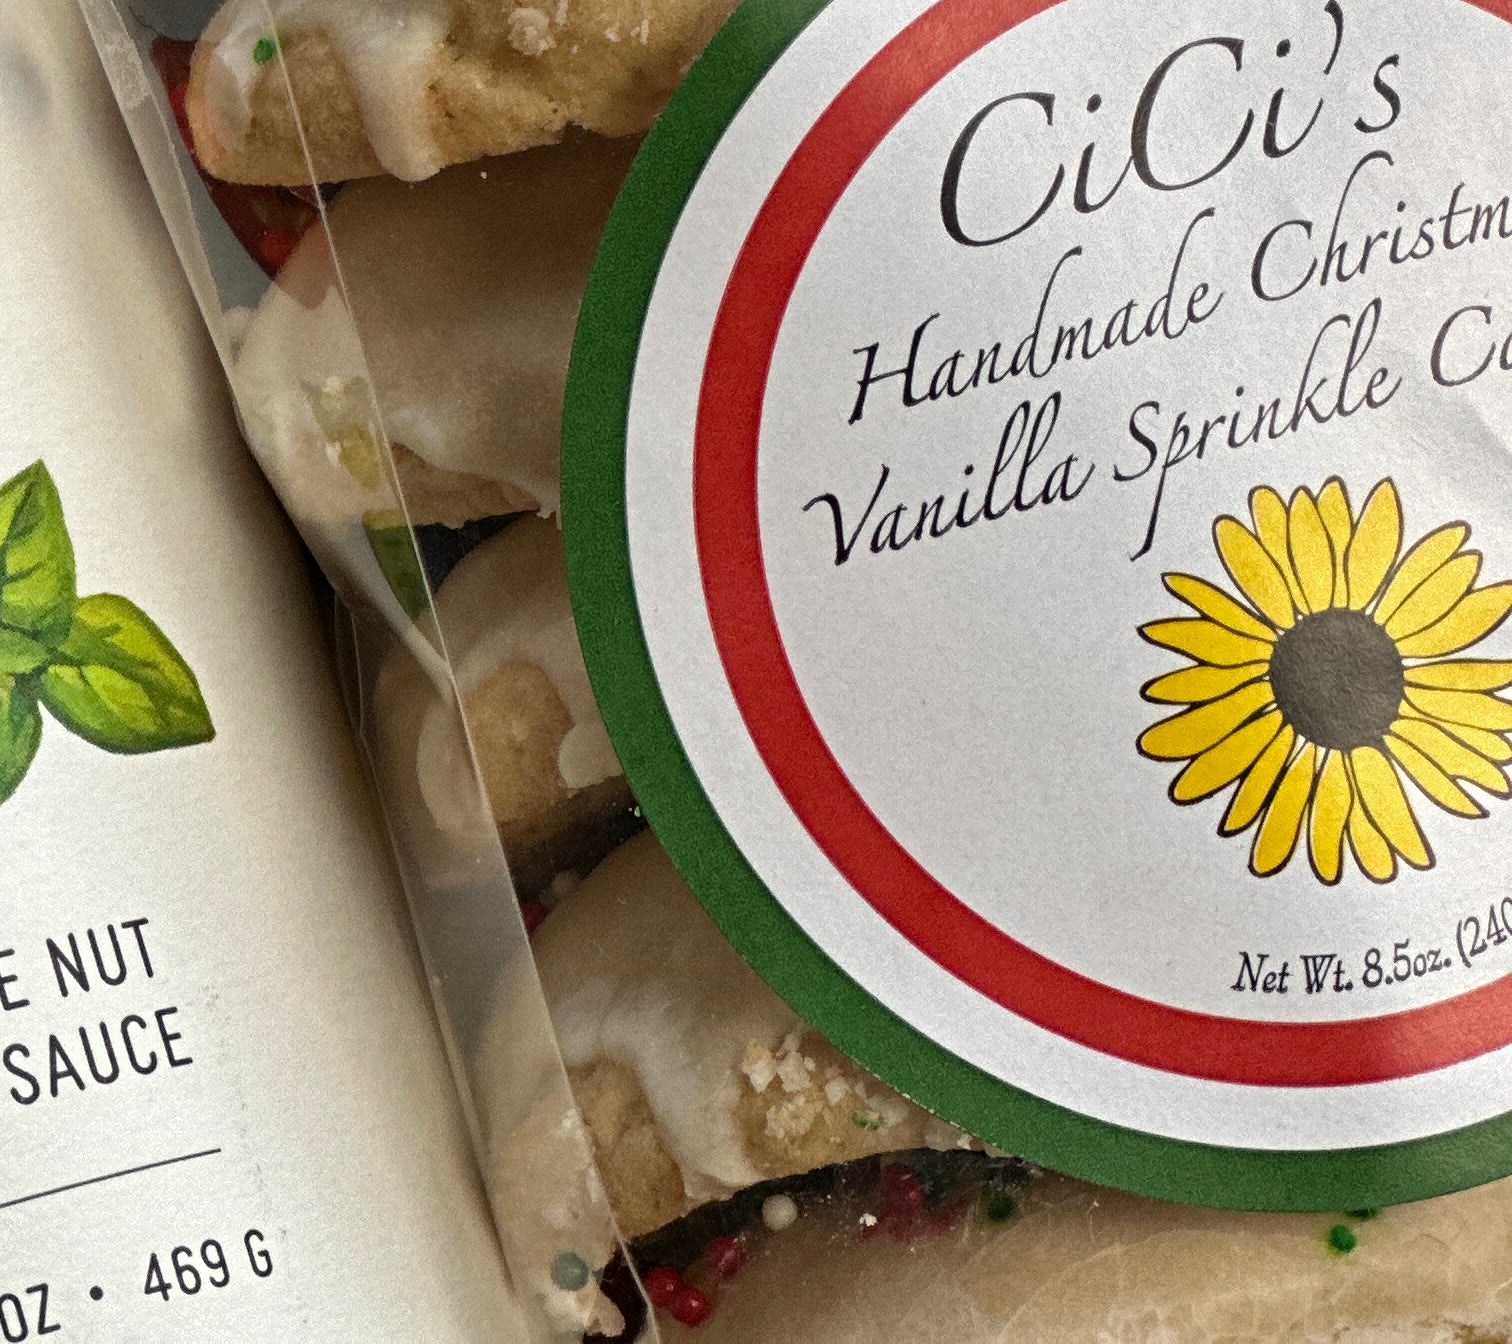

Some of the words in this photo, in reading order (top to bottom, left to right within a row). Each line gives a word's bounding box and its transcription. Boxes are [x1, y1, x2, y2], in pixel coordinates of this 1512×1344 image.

[848, 206, 1225, 427] Handmade
[1250, 149, 1512, 302] Christm
[802, 392, 1095, 567] Vanilla
[1112, 297, 1402, 563] Sprinkle
[45, 917, 157, 998] NUT
[1230, 951, 1294, 995] Net
[1299, 953, 1355, 995] Wt.
[1361, 938, 1452, 990] 8.5oz.
[1, 1005, 194, 1105] SAUCE
[143, 1245, 232, 1302] 469
[244, 1228, 274, 1278] G
